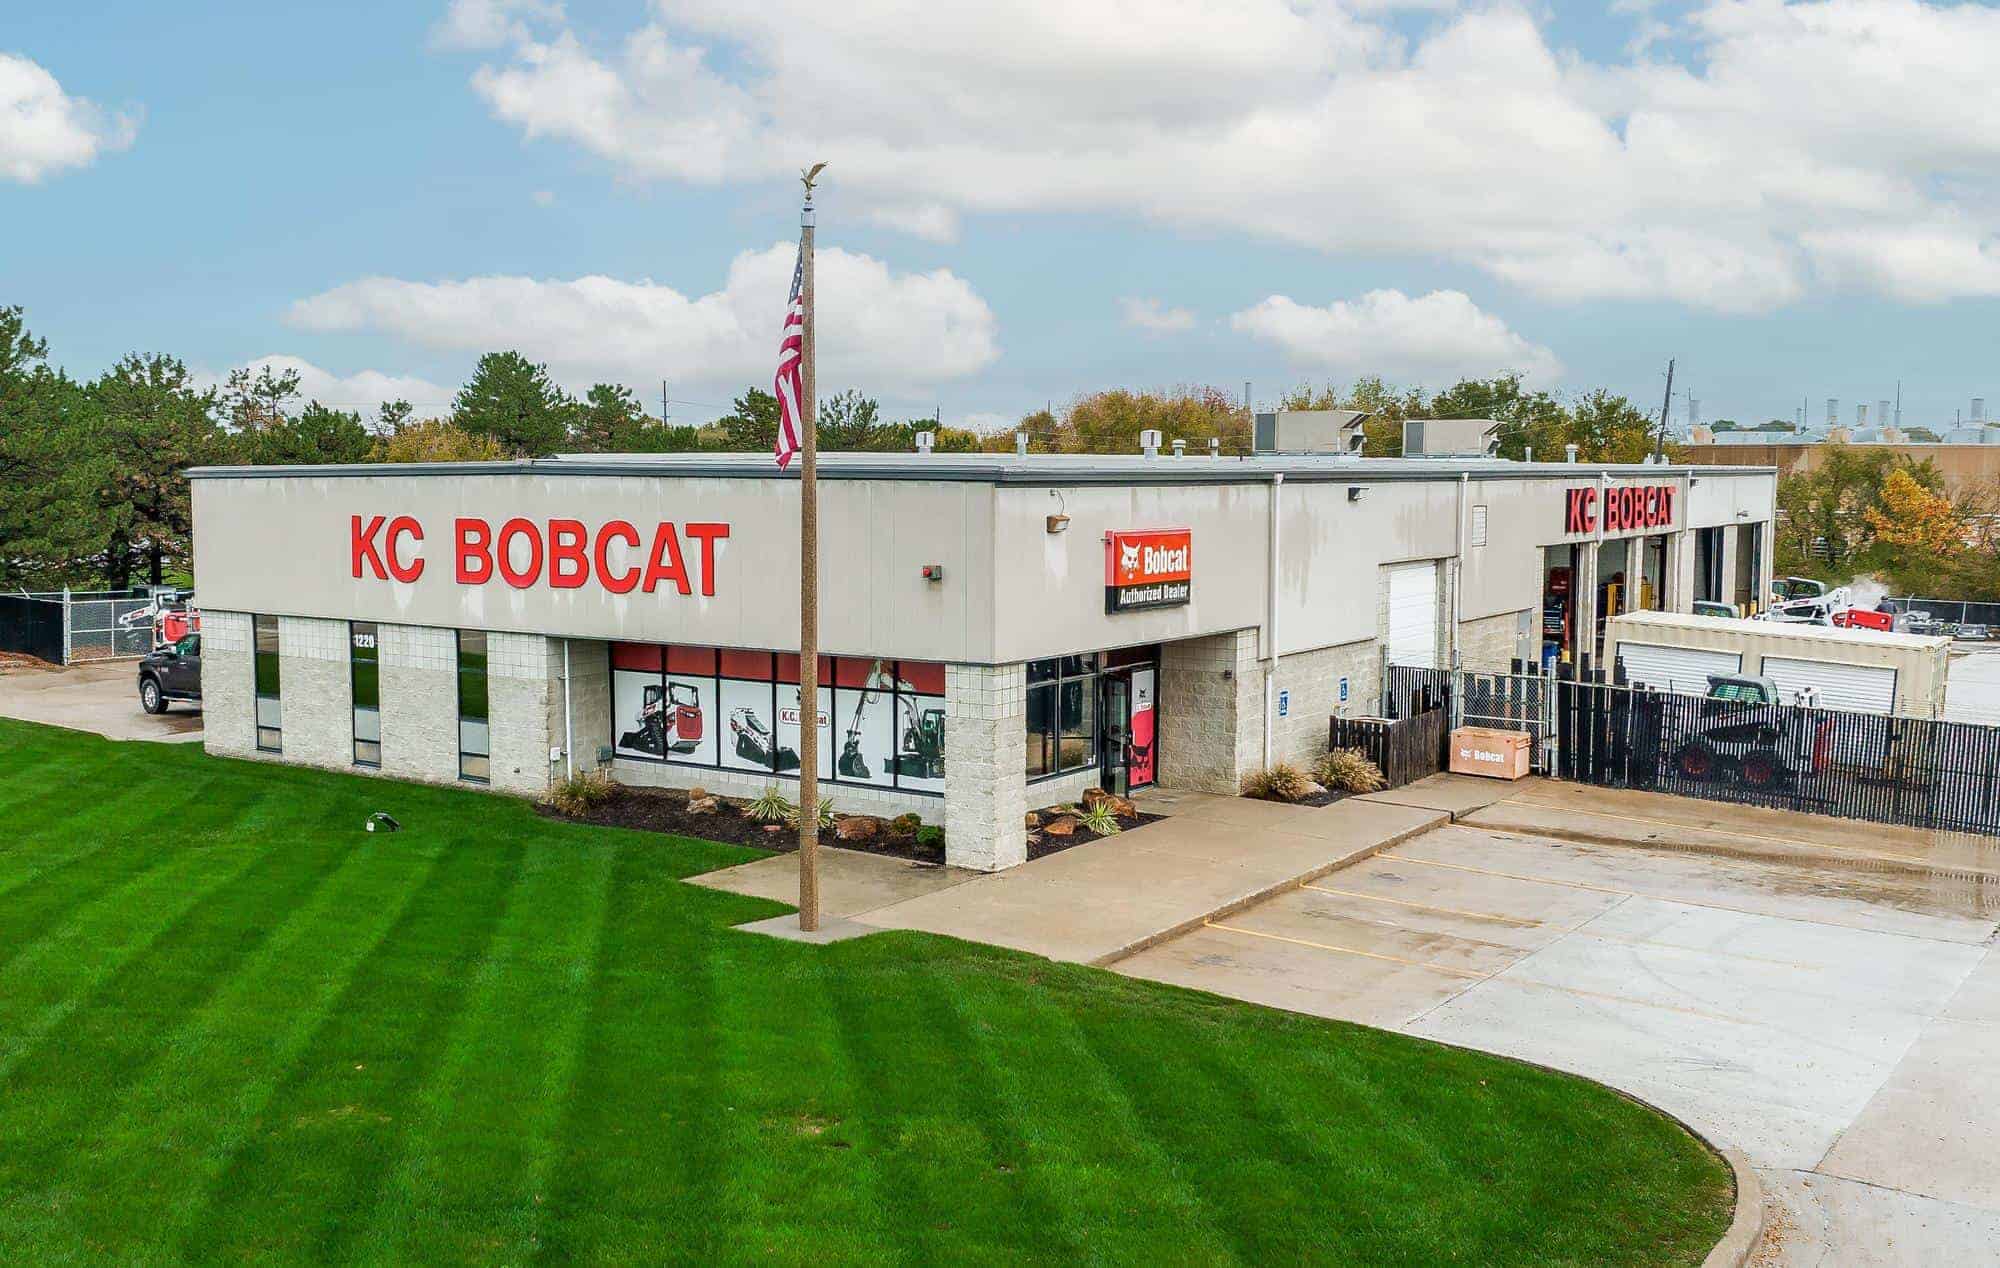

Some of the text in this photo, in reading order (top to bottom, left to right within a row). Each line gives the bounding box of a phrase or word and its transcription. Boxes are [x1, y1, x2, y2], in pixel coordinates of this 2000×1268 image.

[1567, 485, 1677, 533] KC BOBCAT
[352, 515, 730, 597] KC BOBCAT
[1144, 545, 1188, 575] Bobcat
[1120, 584, 1188, 605] Authorized Dealer
[353, 634, 375, 648] 1220
